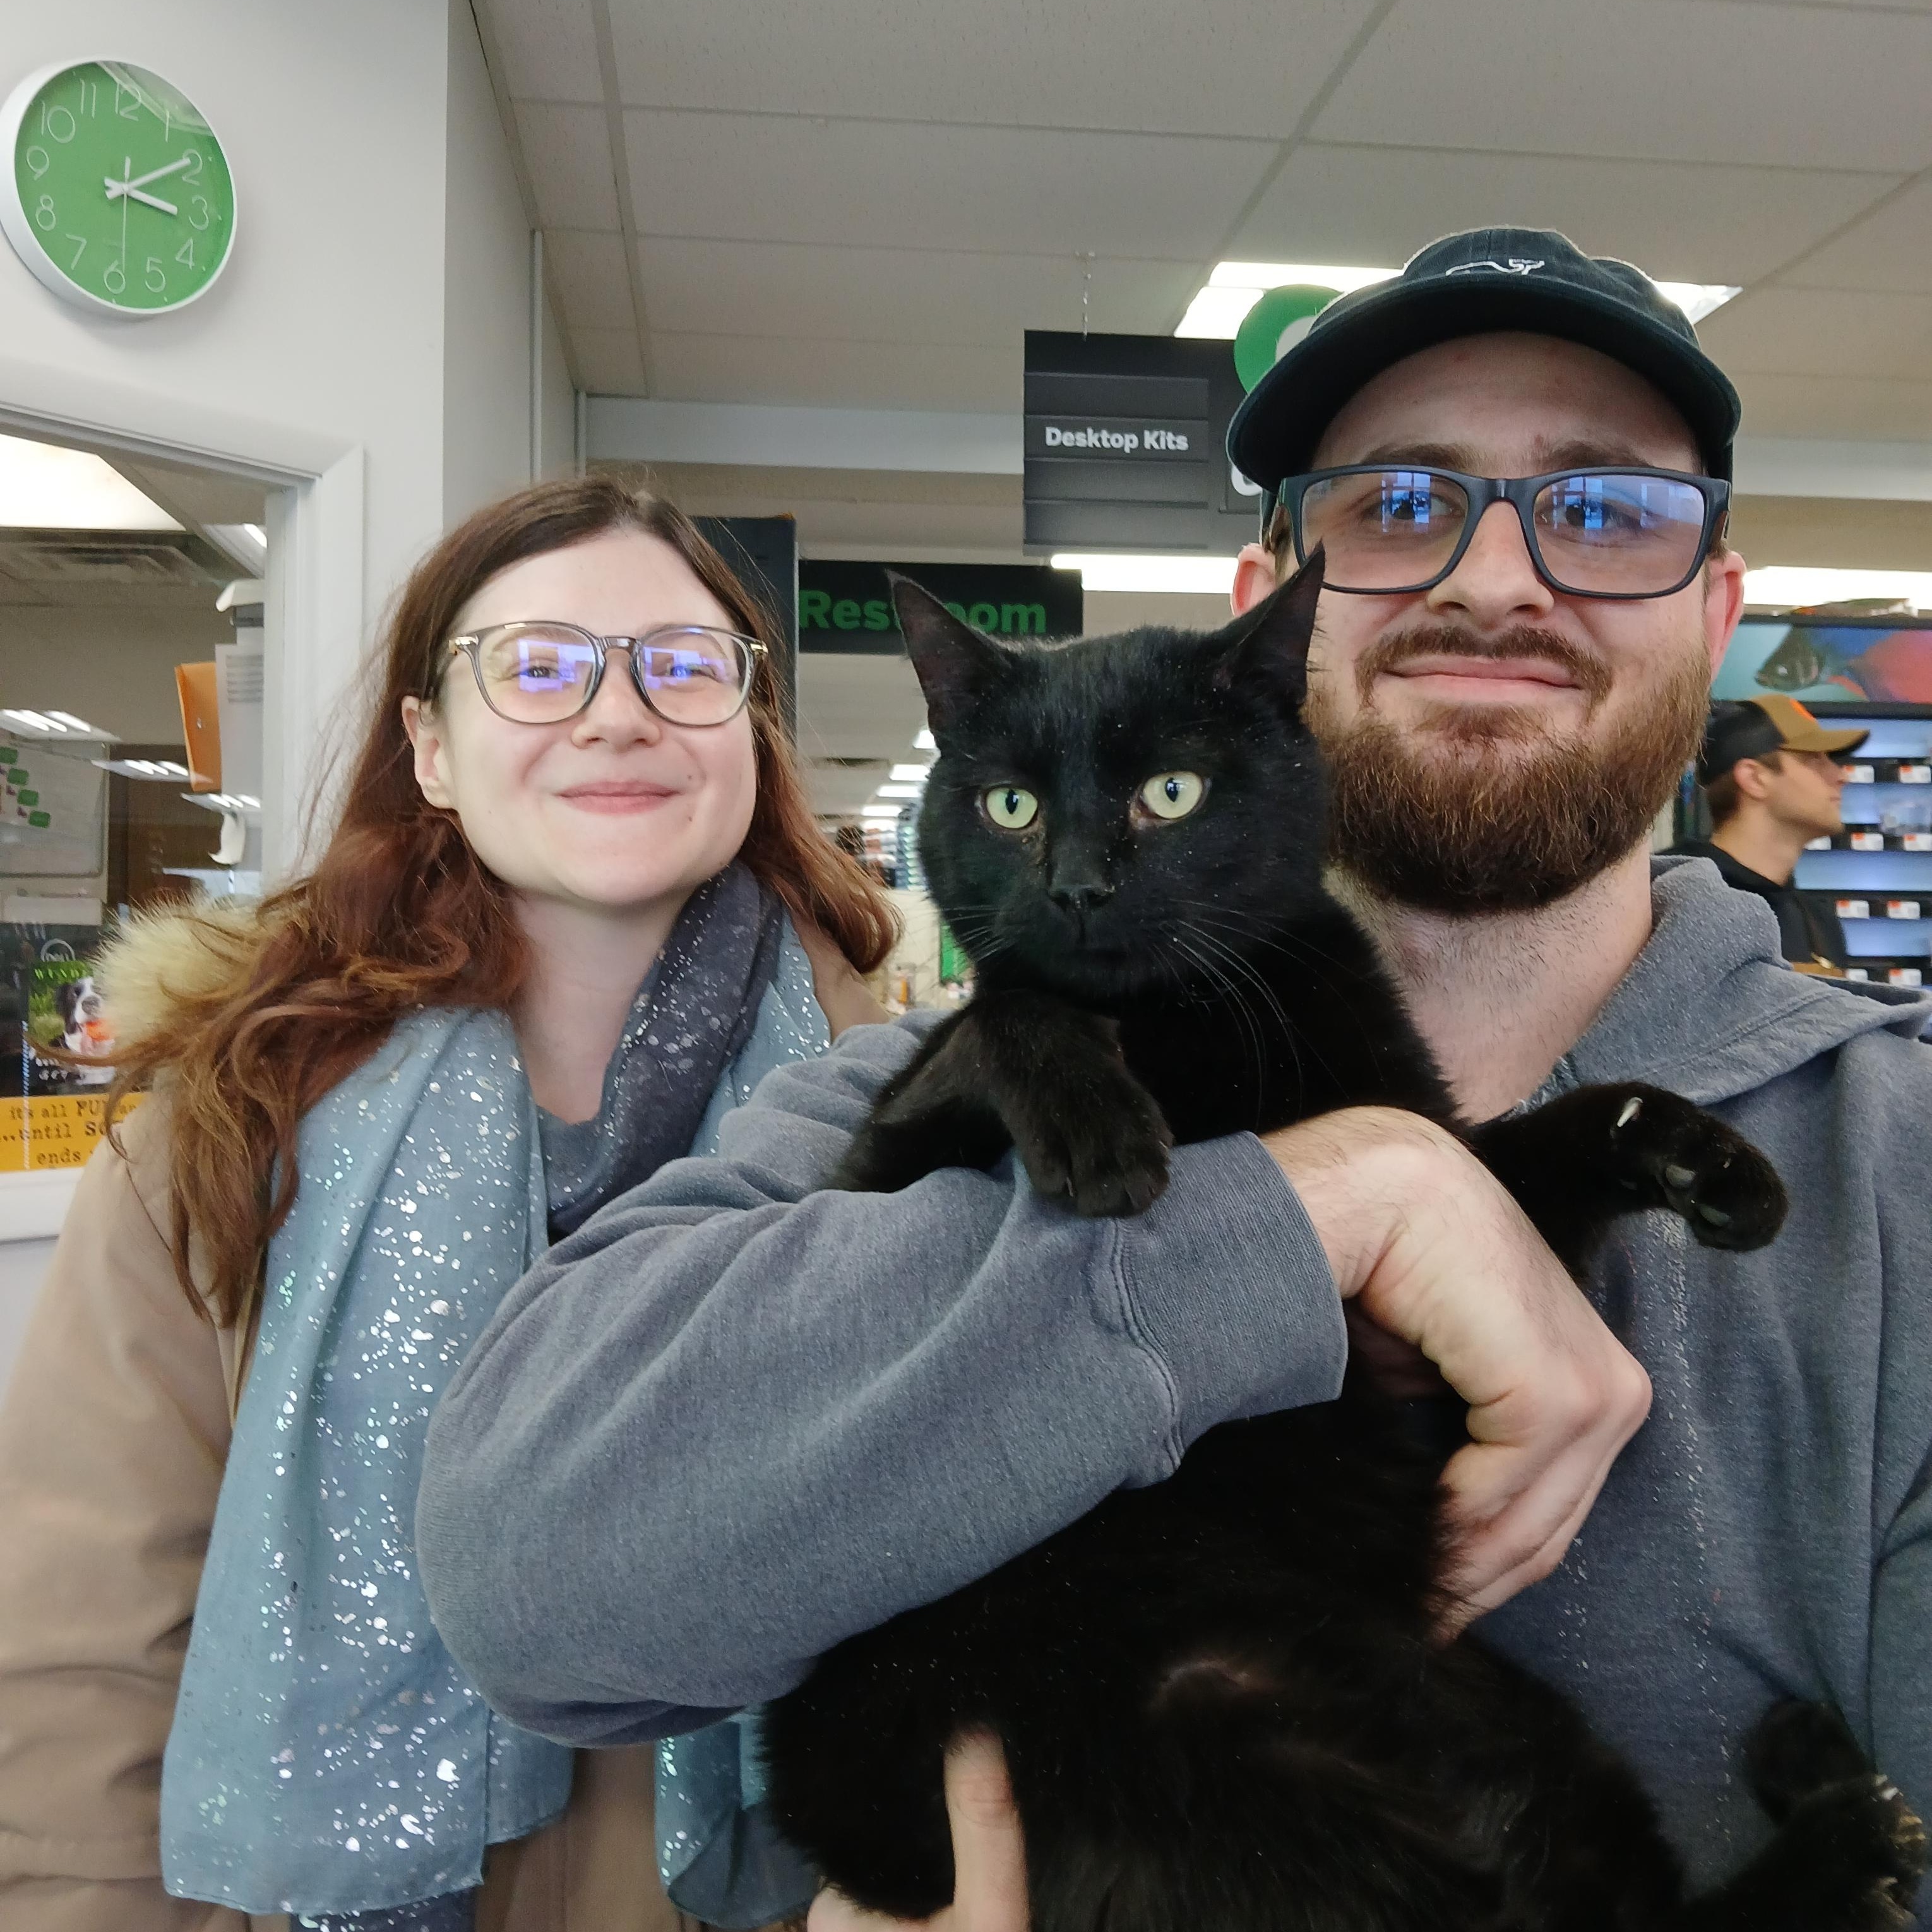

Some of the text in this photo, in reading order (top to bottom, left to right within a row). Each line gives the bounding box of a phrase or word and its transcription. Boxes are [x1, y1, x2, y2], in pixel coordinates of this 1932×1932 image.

[80, 78, 97, 119] 11
[115, 83, 143, 122] 12
[42, 100, 76, 144] 10
[26, 145, 50, 181] 9
[182, 148, 203, 186] 2
[35, 193, 56, 232] 8
[189, 194, 210, 230] 3
[65, 233, 88, 270] 7
[175, 237, 195, 270] 4
[103, 259, 126, 295] 6
[145, 256, 166, 293] 5
[1045, 426, 1190, 454] Desktop Kits
[798, 589, 1047, 634] Resom
[41, 1104, 68, 1118] all
[36, 1146, 81, 1165] ends
